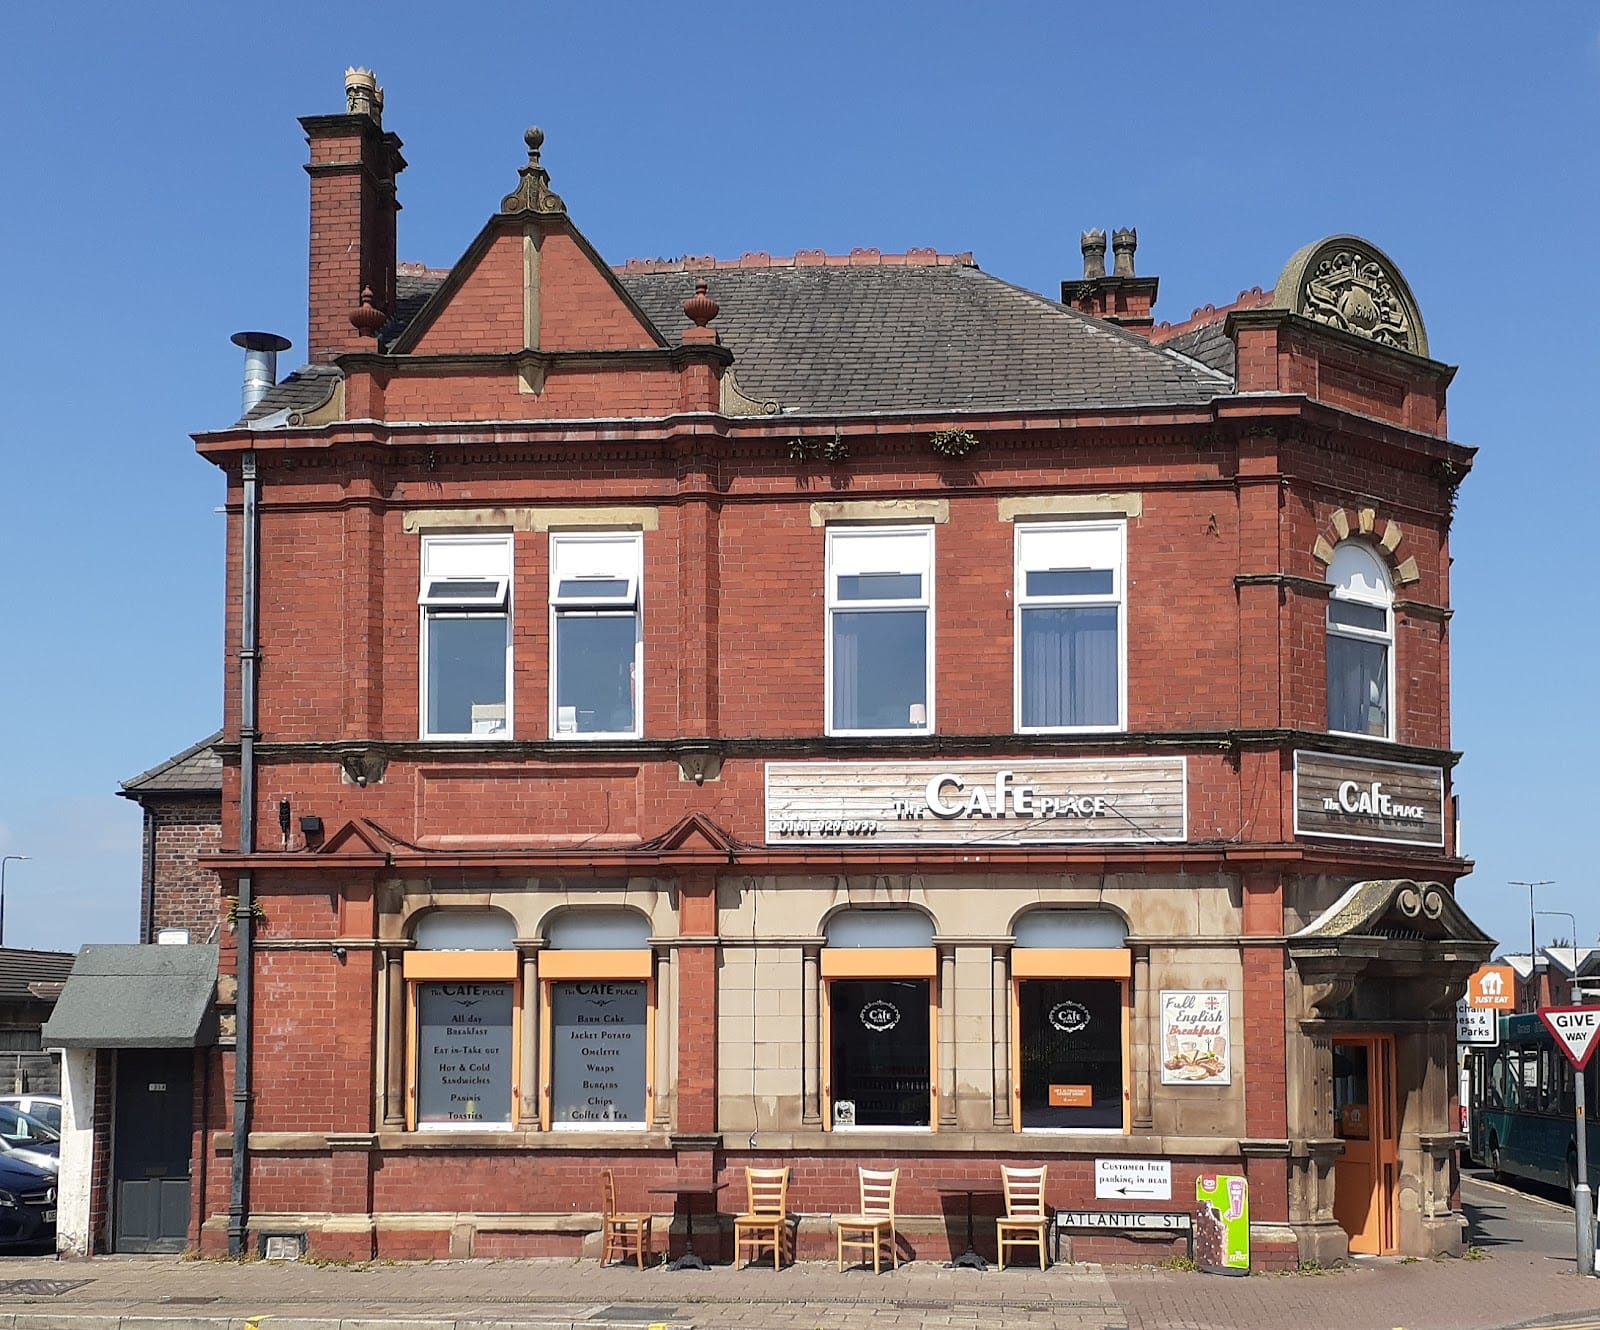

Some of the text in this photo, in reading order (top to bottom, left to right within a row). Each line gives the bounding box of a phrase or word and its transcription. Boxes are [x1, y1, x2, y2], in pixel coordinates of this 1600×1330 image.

[779, 819, 811, 836] 0161
[818, 819, 842, 836] 929
[1165, 995, 1196, 1009] Full
[1475, 996, 1492, 1004] JUST
[1176, 1010, 1224, 1024] English
[1479, 1016, 1485, 1024] &
[1556, 1014, 1595, 1027] GIVE
[1169, 1024, 1222, 1037] Breakfast
[1461, 1027, 1489, 1036] Parks
[1565, 1032, 1587, 1041] WAY
[459, 1064, 465, 1072] &
[602, 1111, 609, 1119] &
[1136, 1175, 1145, 1183] in
[1065, 1213, 1181, 1227] ATLANTIC ST
